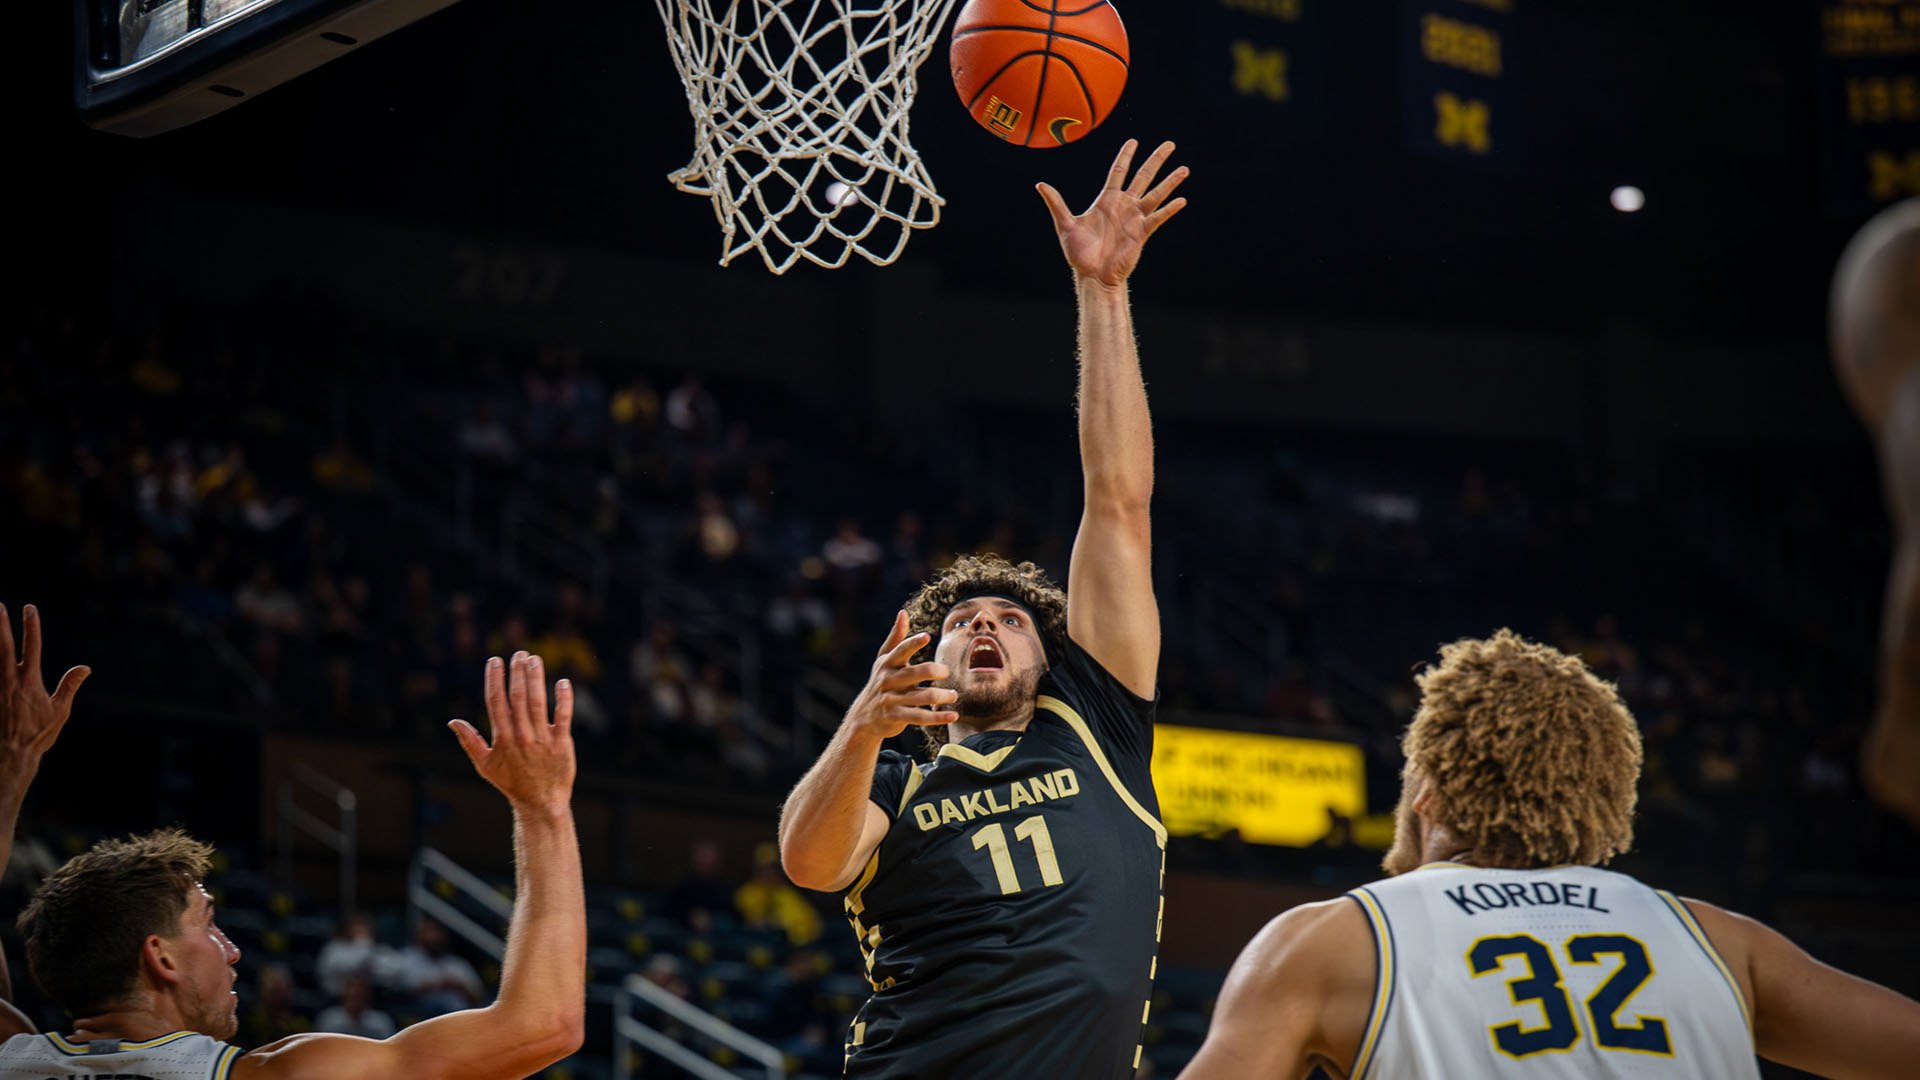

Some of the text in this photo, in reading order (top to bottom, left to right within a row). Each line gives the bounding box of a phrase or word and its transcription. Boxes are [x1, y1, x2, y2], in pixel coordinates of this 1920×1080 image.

[913, 768, 1080, 831] OAKLAND
[971, 815, 1063, 895] 11
[1445, 882, 1609, 915] KORDEL
[1466, 933, 1674, 1059] 32
